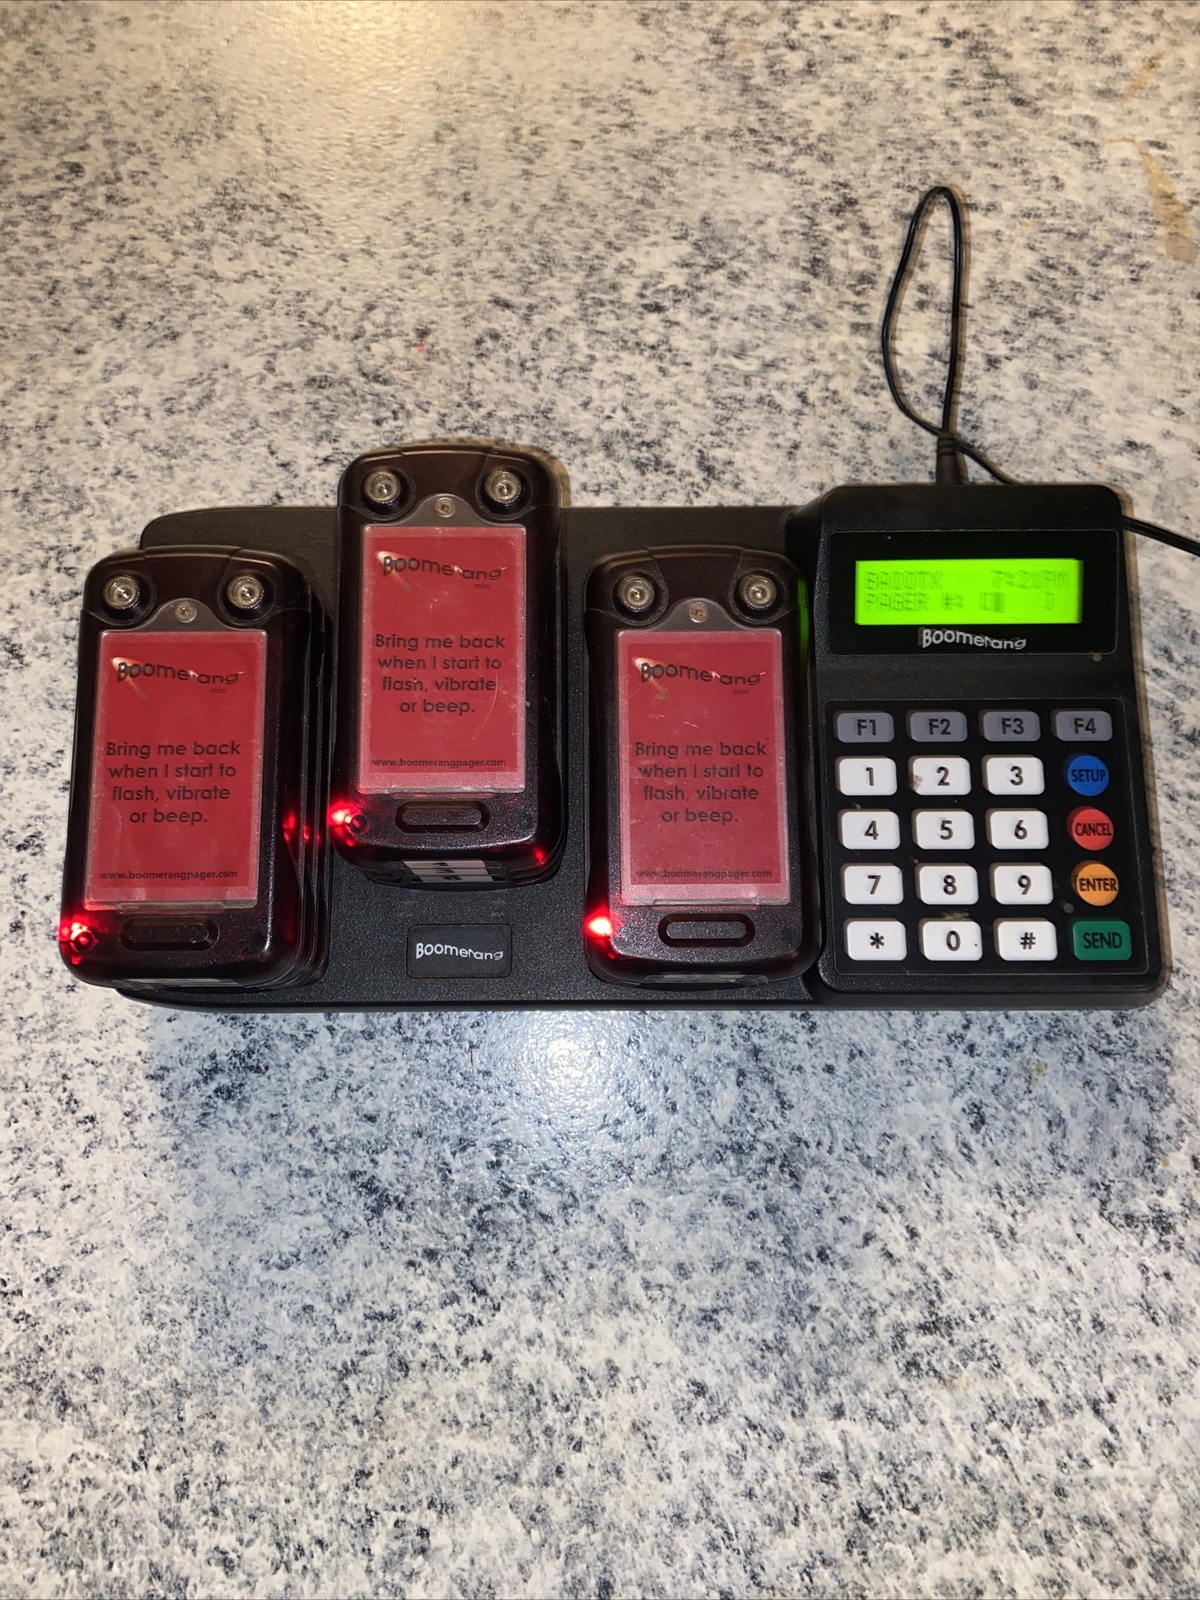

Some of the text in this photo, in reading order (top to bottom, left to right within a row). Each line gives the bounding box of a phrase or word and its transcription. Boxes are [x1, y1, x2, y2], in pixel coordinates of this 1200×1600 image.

[864, 591, 930, 612] PAGER
[374, 633, 506, 652] Bring me back
[921, 628, 1027, 650] Boomerang
[377, 655, 502, 670] when I start to
[381, 676, 496, 693] flash, vibrate
[399, 699, 476, 717] or beep.
[856, 718, 878, 736] F1
[928, 718, 952, 735] F2
[1001, 717, 1025, 735] F3
[1073, 717, 1097, 735] F4
[105, 741, 241, 759] Bring me back
[634, 741, 767, 760] Bring me back
[108, 763, 237, 778] when I start to
[371, 757, 507, 769] www.boomerangpager.com
[638, 764, 764, 779] when I start to
[865, 767, 875, 786] 1
[936, 766, 950, 786] 2
[1010, 766, 1024, 786] 3
[1071, 768, 1106, 783] SETUP
[112, 785, 231, 802] flash, vibrate
[643, 785, 759, 802] flash, vibrate
[129, 808, 208, 827] or beep.
[661, 808, 738, 826] or beep.
[864, 820, 879, 840] 4
[940, 820, 953, 840] 5
[1014, 820, 1028, 840] 6
[1075, 822, 1112, 837] CANCEL
[99, 870, 238, 882] www.boomerangpager.com
[867, 875, 882, 895] 7
[942, 875, 958, 895] 8
[1018, 875, 1032, 895] 9
[1079, 878, 1118, 892] ENTER
[946, 930, 961, 951] 0
[1020, 932, 1036, 950] #
[1083, 932, 1123, 949] SEND
[415, 942, 504, 961] Boomerang
